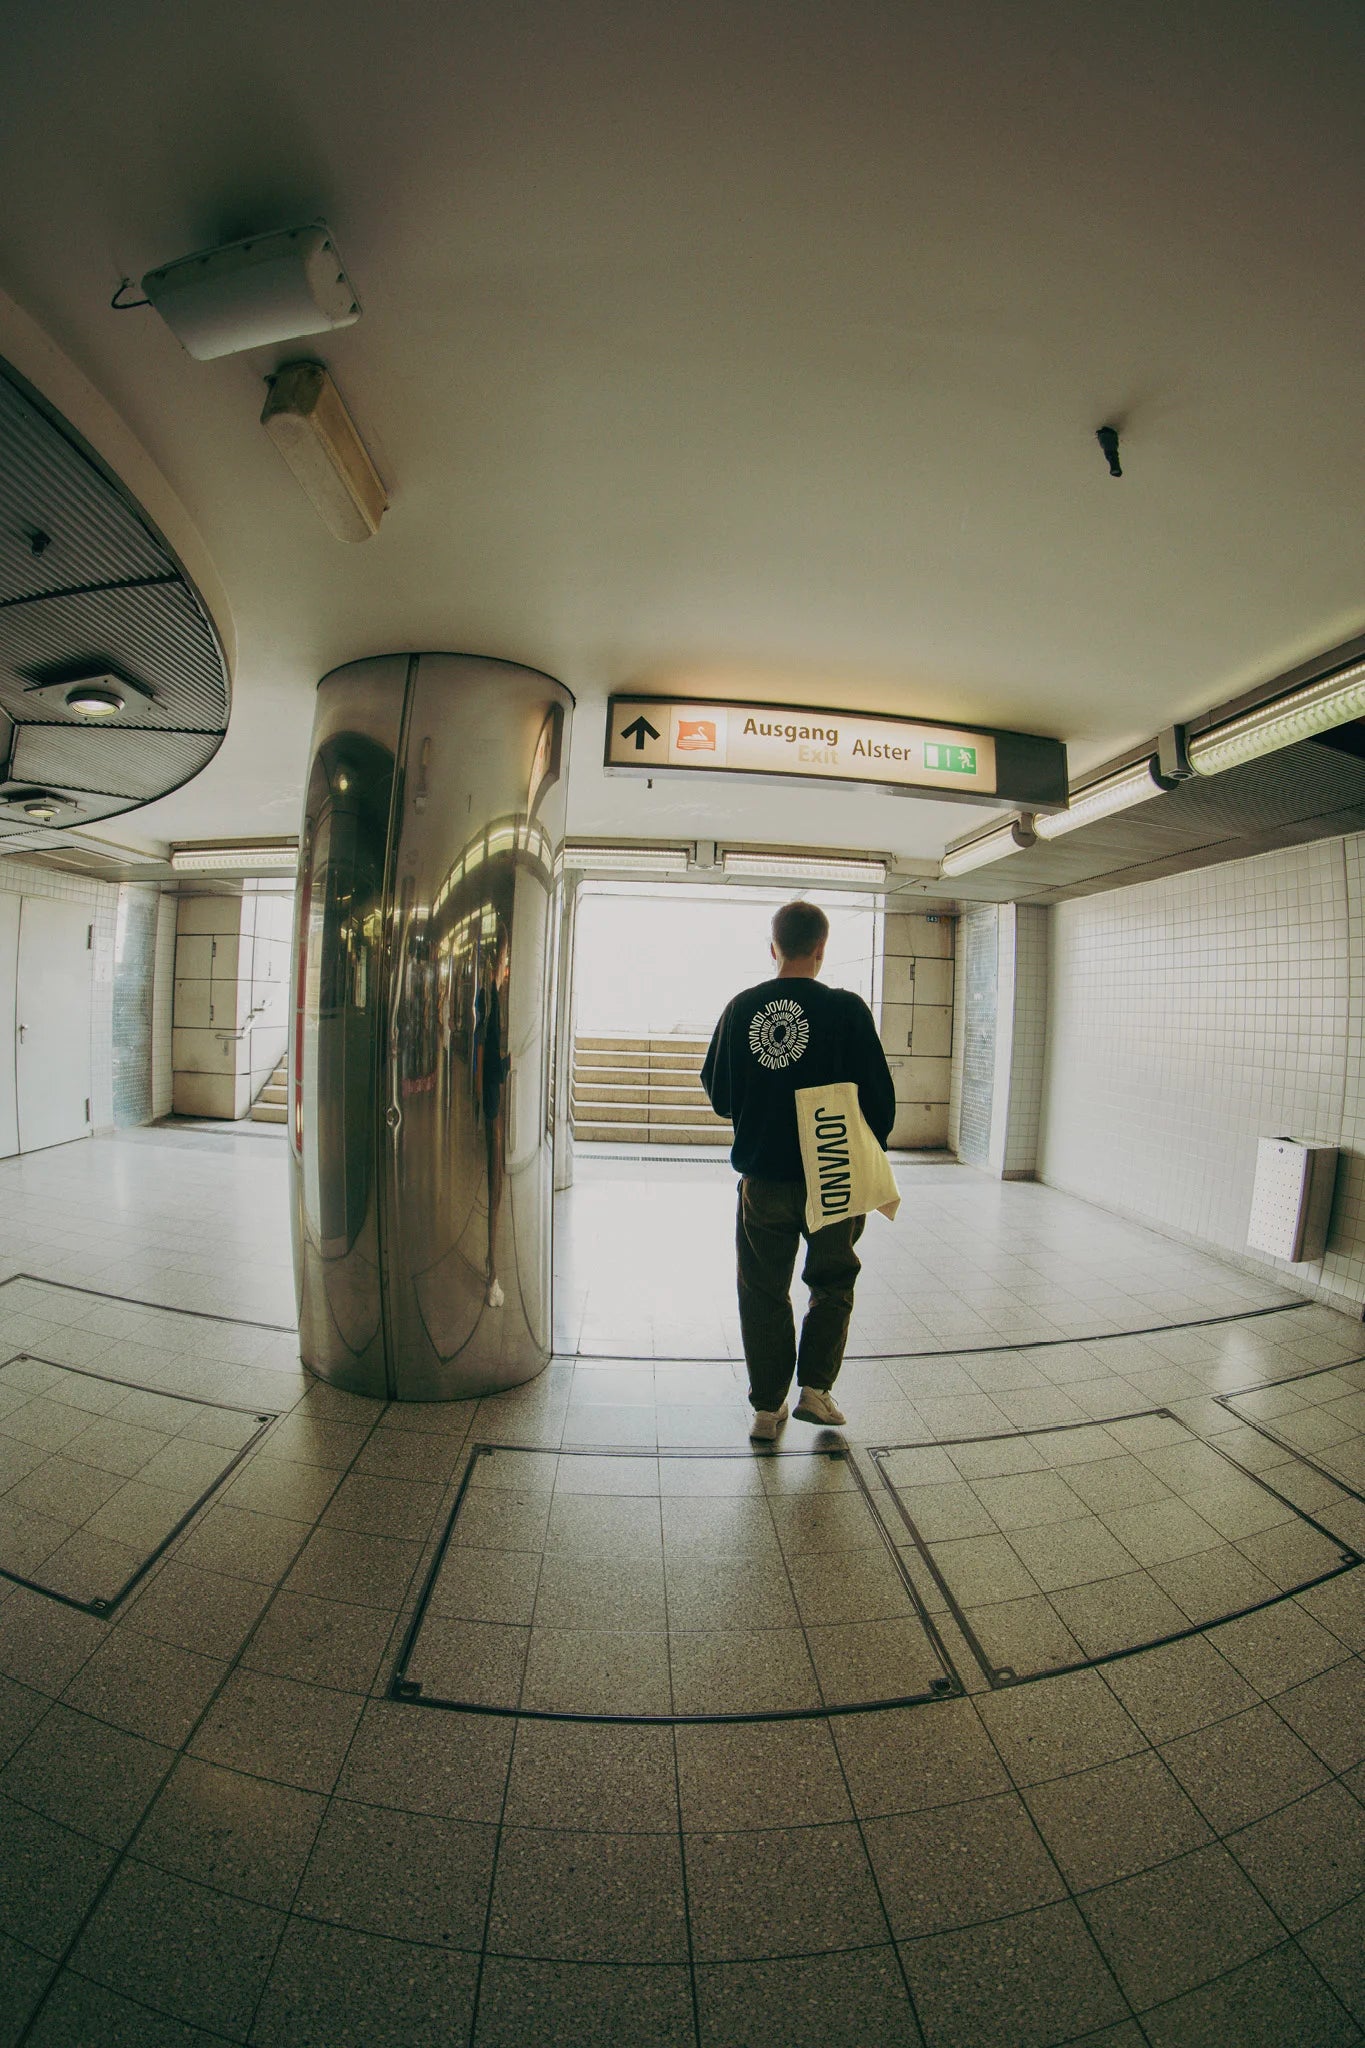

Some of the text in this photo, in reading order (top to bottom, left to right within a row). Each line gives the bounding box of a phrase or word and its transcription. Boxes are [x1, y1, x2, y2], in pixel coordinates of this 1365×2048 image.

[743, 718, 839, 746] Ausgang
[799, 745, 839, 764] Exit
[852, 739, 911, 761] Alster
[764, 999, 804, 1019] JOVANDI
[749, 1011, 767, 1054] JOVANDI
[789, 1018, 810, 1062] JOVANDI
[757, 1052, 790, 1070] JOVANDI
[814, 1107, 851, 1217] JOVANDI
